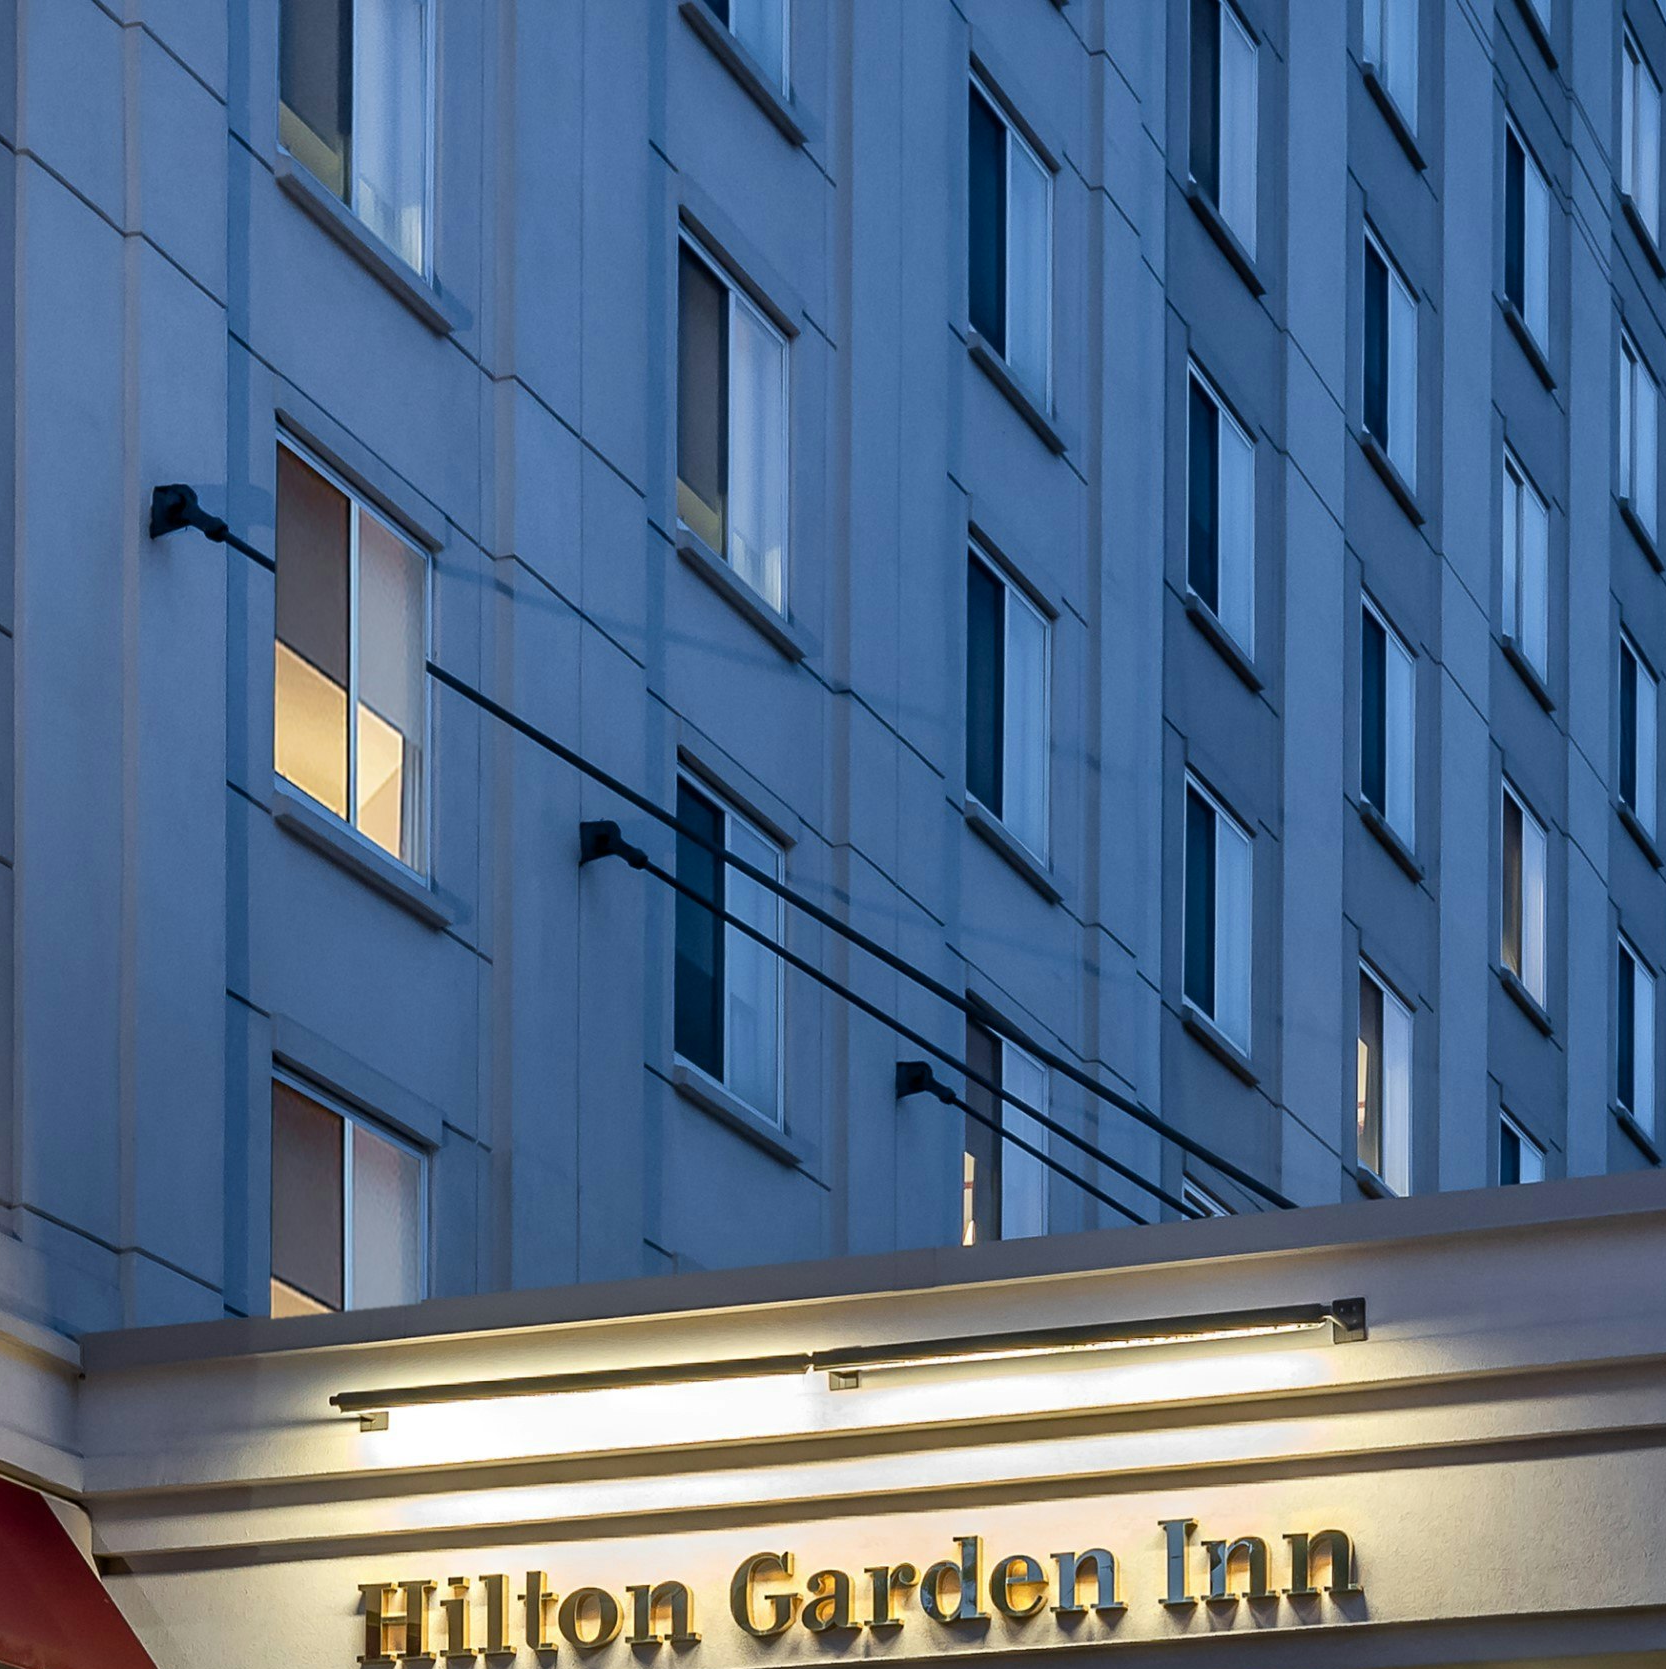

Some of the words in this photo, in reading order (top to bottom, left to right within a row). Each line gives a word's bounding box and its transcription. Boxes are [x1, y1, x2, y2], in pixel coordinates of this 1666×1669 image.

[357, 1571, 702, 1664] Hilton
[730, 1535, 1129, 1637] Garden
[1158, 1518, 1364, 1610] Inn
